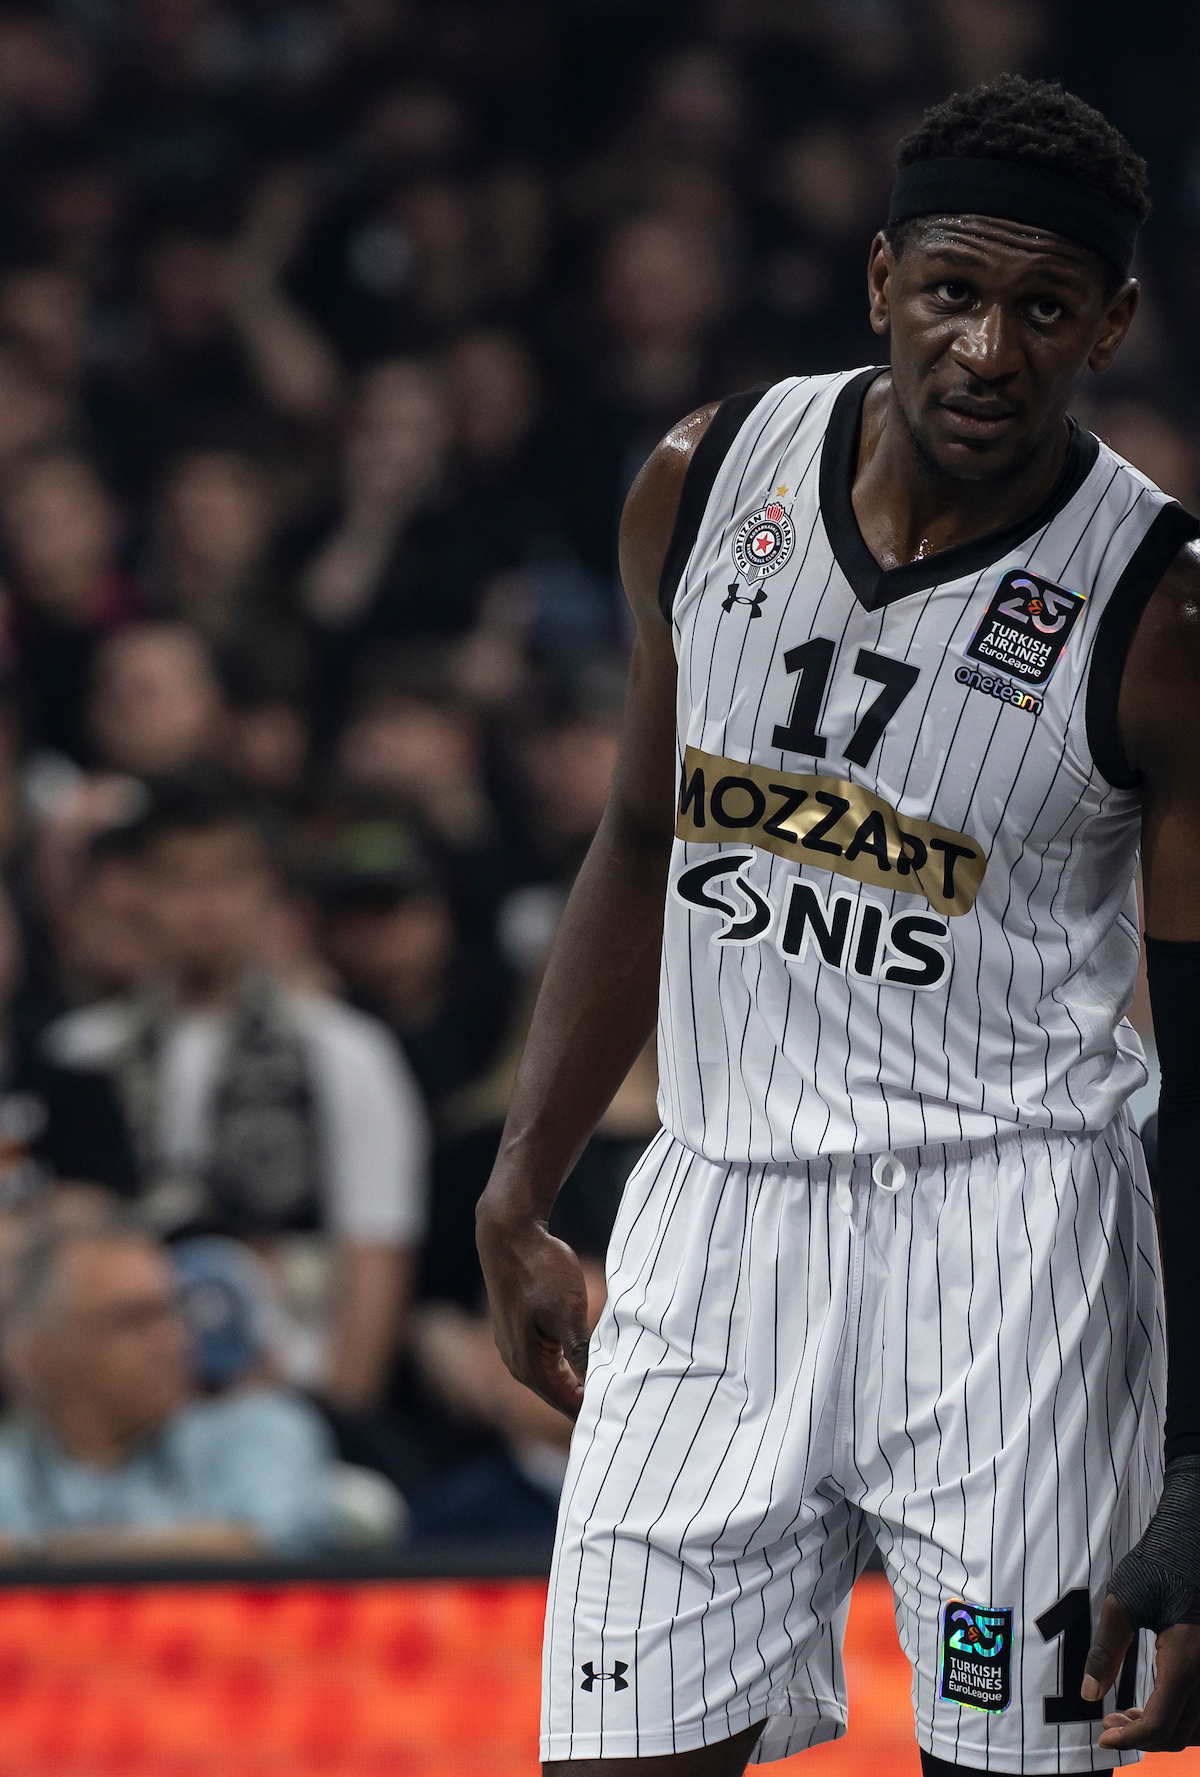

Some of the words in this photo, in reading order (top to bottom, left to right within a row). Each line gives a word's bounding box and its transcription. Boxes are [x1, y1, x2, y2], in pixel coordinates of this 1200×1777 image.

[736, 514, 762, 569] PARTIZAN
[762, 520, 792, 574] ПАРТИЗАН
[998, 578, 1075, 634] 25
[978, 642, 1042, 677] EuroLeague
[983, 632, 1048, 667] AIRLINES
[991, 621, 1052, 657] TURKISH
[771, 636, 921, 768] 17
[956, 667, 1043, 714] oneteam
[680, 761, 976, 899] MOZZART
[782, 882, 948, 986] NIS
[949, 1609, 1005, 1658] 25
[949, 1669, 1002, 1690] AIRLINES
[949, 1680, 1002, 1702] EuroLeague
[950, 1657, 1002, 1678] TURKISH
